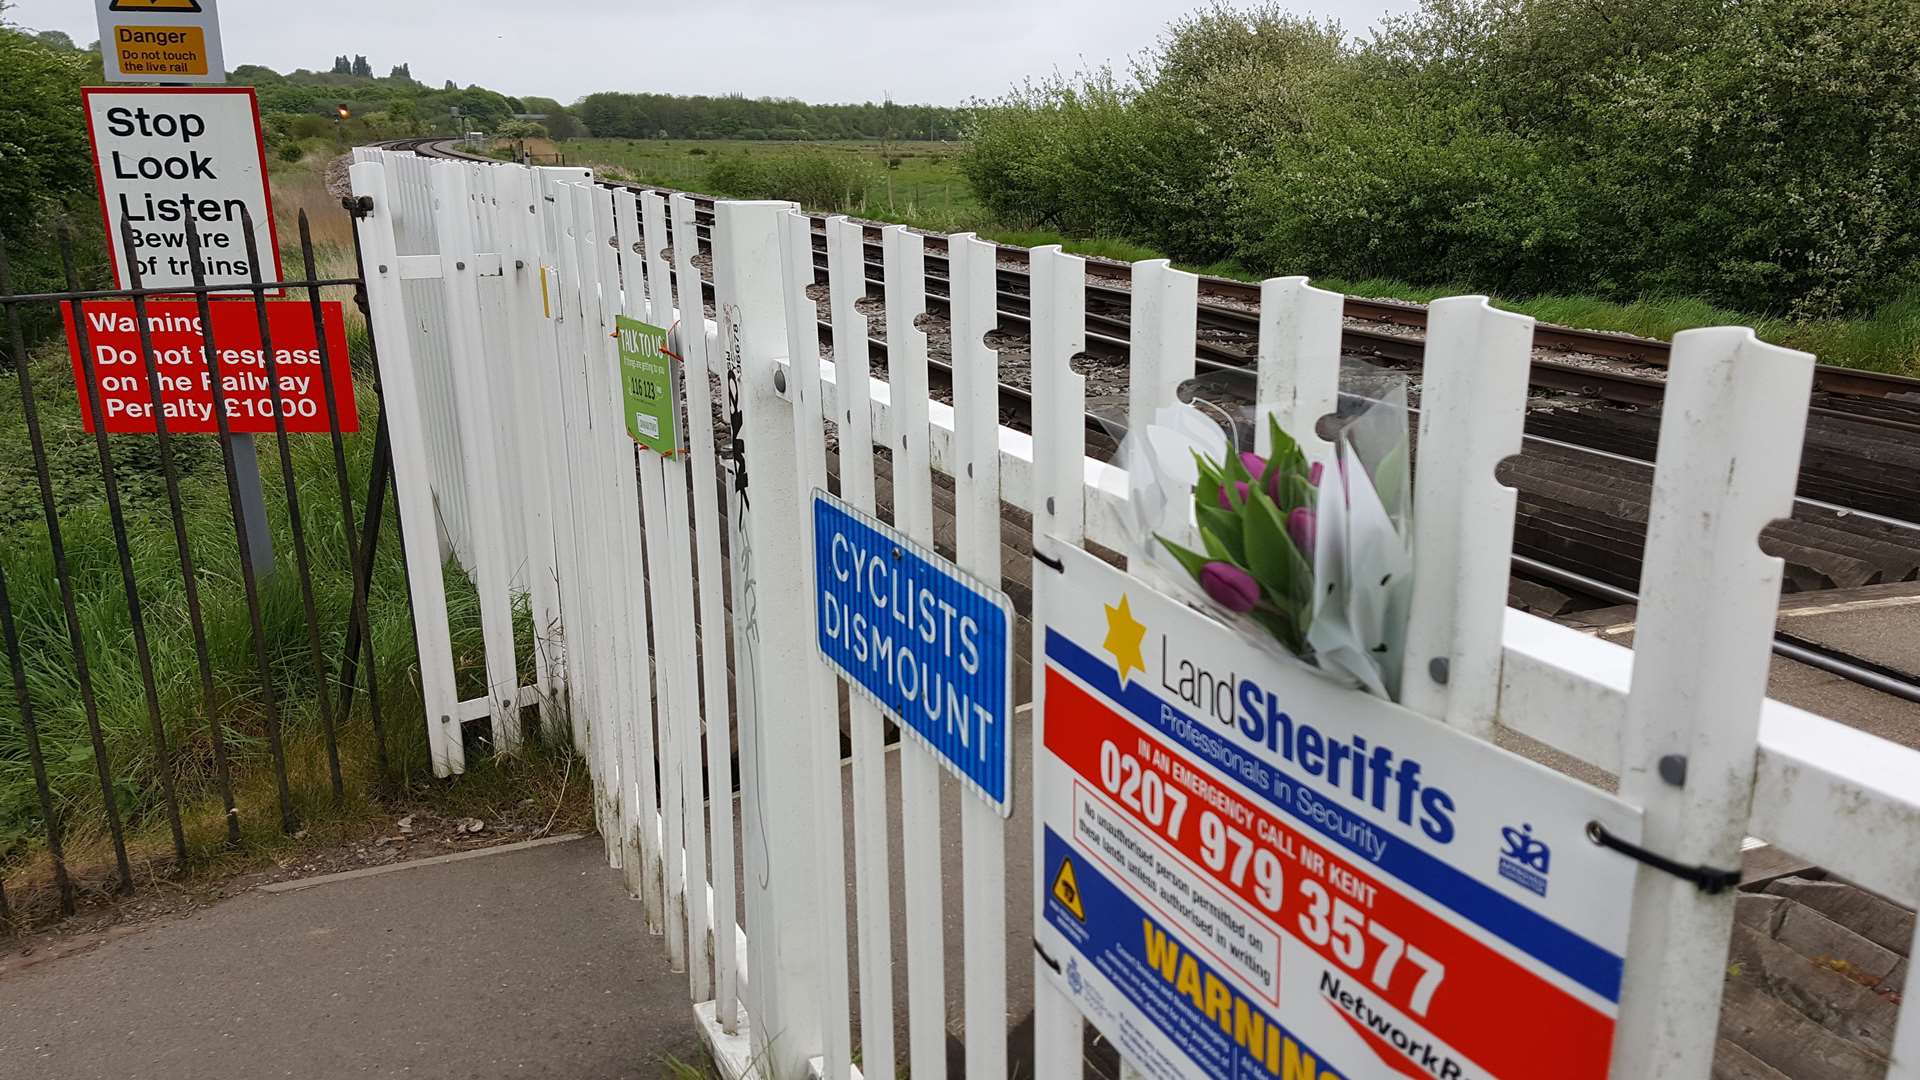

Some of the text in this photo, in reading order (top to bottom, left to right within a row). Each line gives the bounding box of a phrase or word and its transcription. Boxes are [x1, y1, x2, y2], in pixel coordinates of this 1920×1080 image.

[119, 29, 186, 45] Danger
[122, 50, 197, 61] Do not touch
[124, 62, 188, 72] the live rail
[107, 107, 205, 143] Stop
[112, 150, 217, 179] Look
[119, 193, 247, 221] Listen
[130, 229, 229, 248] Bewre
[168, 257, 249, 276] trins
[88, 312, 204, 336] Waning
[96, 345, 137, 365] Do
[620, 329, 639, 353] TALK
[639, 333, 650, 358] TO
[102, 376, 138, 391] on
[146, 371, 192, 391] he
[631, 377, 656, 400] 116 123
[224, 398, 317, 417] £1000
[832, 532, 979, 675] CYCLISTS
[824, 590, 993, 763] DISMOUNT
[1162, 633, 1456, 845] LandSheriffs
[1160, 704, 1387, 861] Professionals in Security
[1138, 737, 1377, 908] IN AN EMERGENCY CALL NR KENT
[1084, 802, 1263, 952] No unauthorised person permitted on
[1100, 739, 1188, 841] 0207
[1199, 810, 1284, 913] 979
[1298, 877, 1445, 1018] 3577
[1102, 838, 1125, 867] lands
[1127, 861, 1157, 893] unless
[1159, 886, 1214, 940] authorised
[1216, 931, 1227, 949] in
[1230, 942, 1271, 987] writing
[1143, 918, 1344, 1080] WARNIN
[1319, 969, 1471, 1080] NetworkR
